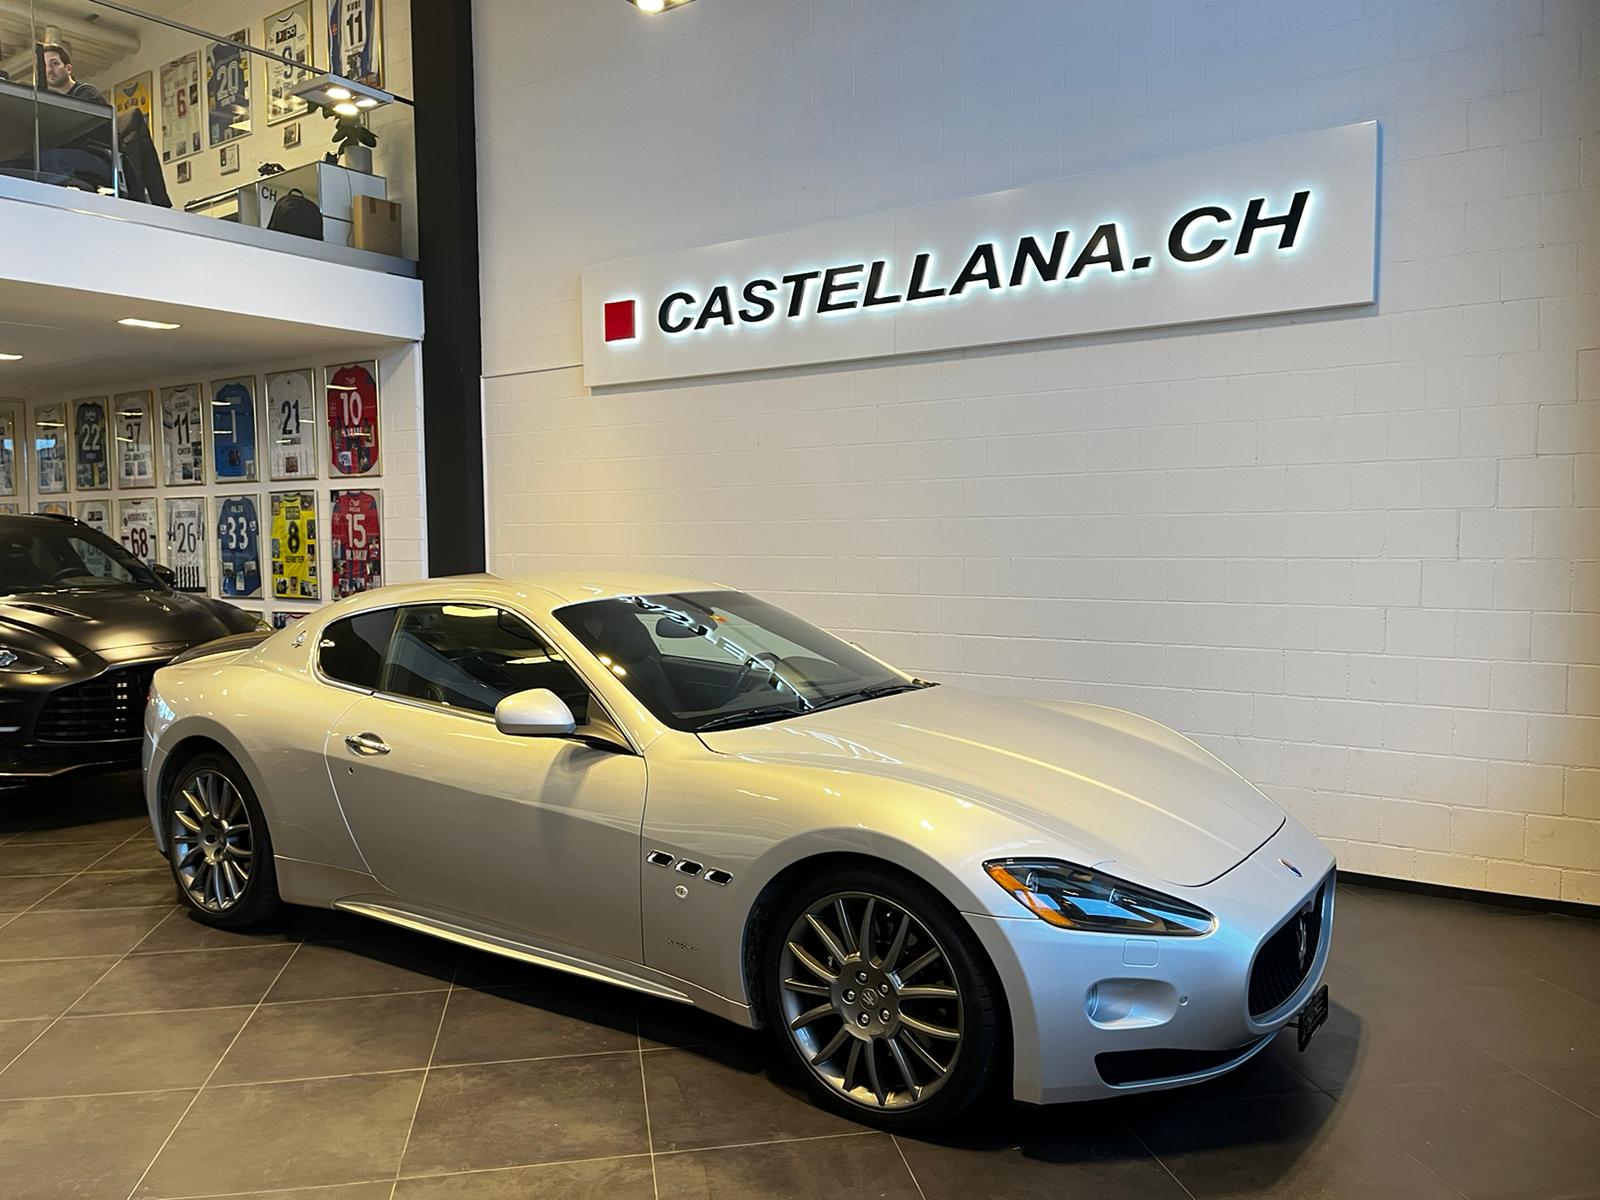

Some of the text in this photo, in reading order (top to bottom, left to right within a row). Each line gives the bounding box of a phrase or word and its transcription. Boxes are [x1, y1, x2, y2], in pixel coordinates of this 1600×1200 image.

[346, 10, 364, 46] 11
[282, 45, 294, 79] 9
[216, 60, 239, 101] 20
[176, 88, 187, 119] 6
[658, 190, 1311, 334] CASTELLANA.CH
[281, 399, 300, 435] 21
[340, 390, 363, 426] 10
[81, 423, 101, 451] 22
[173, 411, 190, 446] 11
[131, 527, 149, 559] 68
[177, 522, 197, 554] 26
[227, 515, 249, 550] 33
[287, 520, 300, 555] 8
[345, 513, 367, 549] 15
